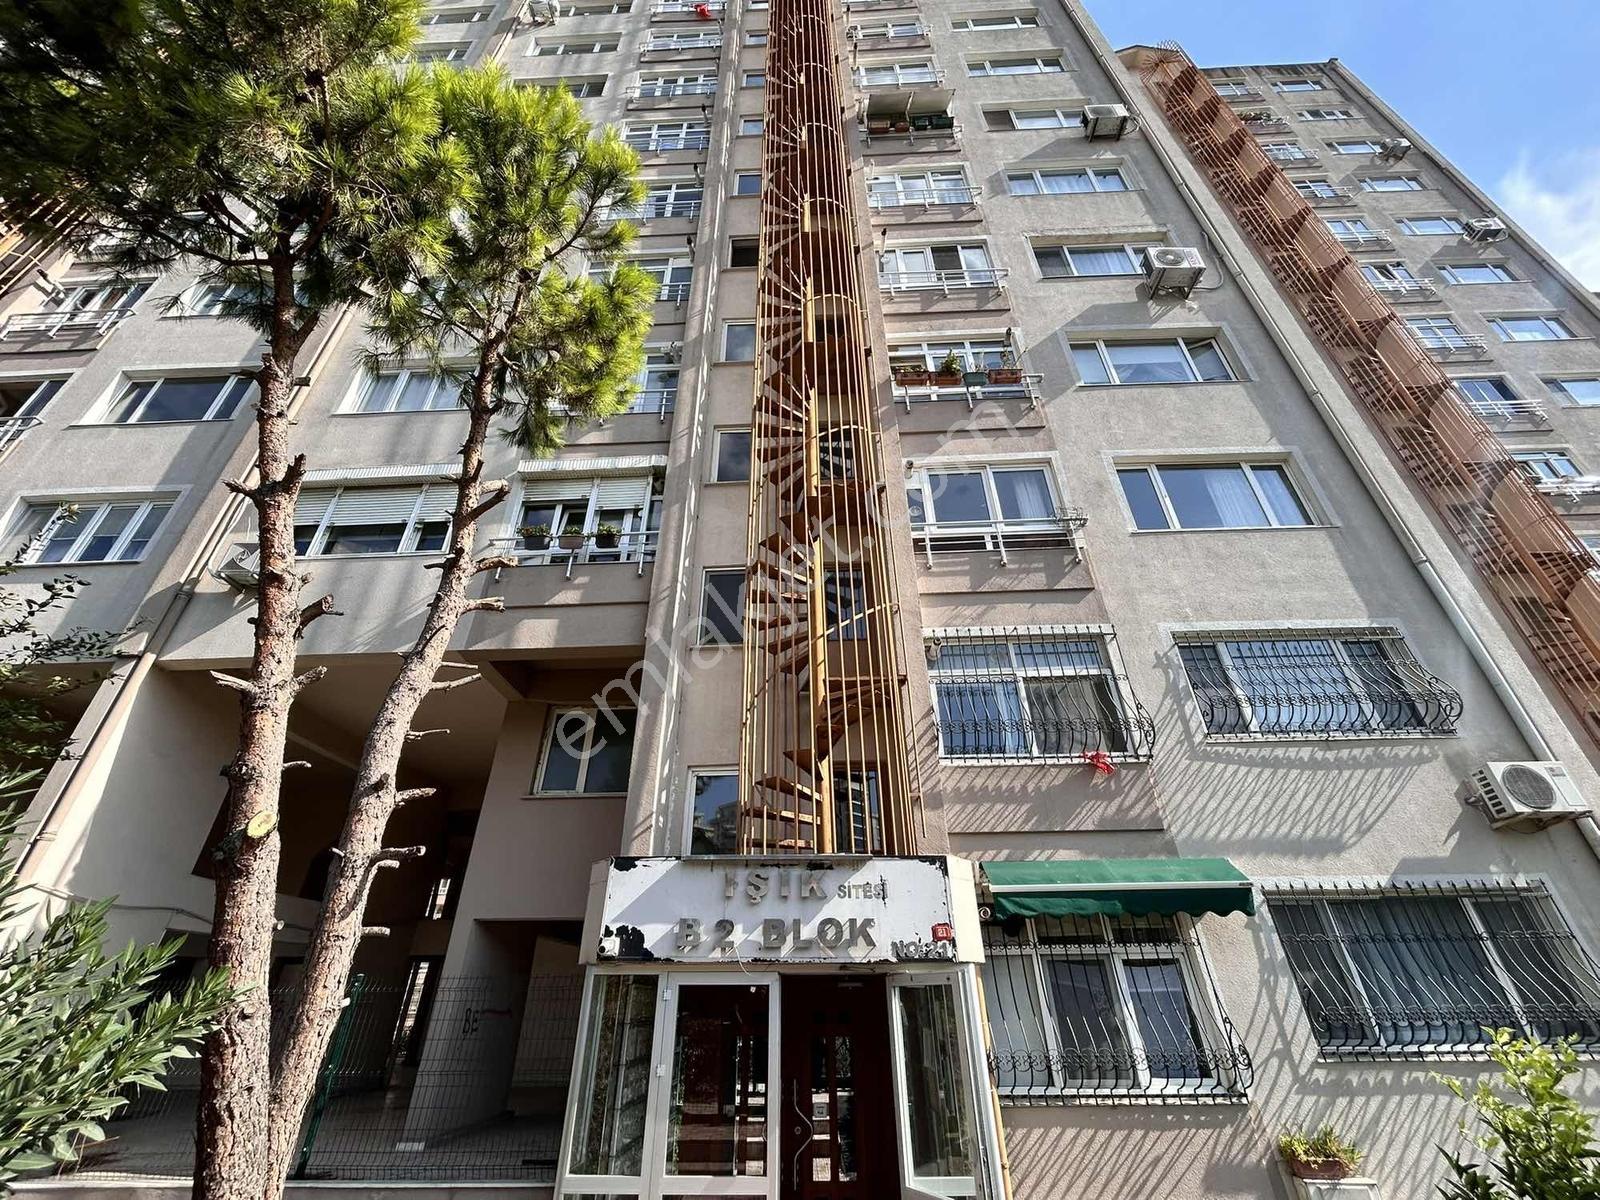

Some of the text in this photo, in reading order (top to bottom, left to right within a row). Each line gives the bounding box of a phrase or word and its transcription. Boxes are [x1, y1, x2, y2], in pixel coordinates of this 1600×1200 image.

[677, 917, 877, 949] B 2 BLOK
